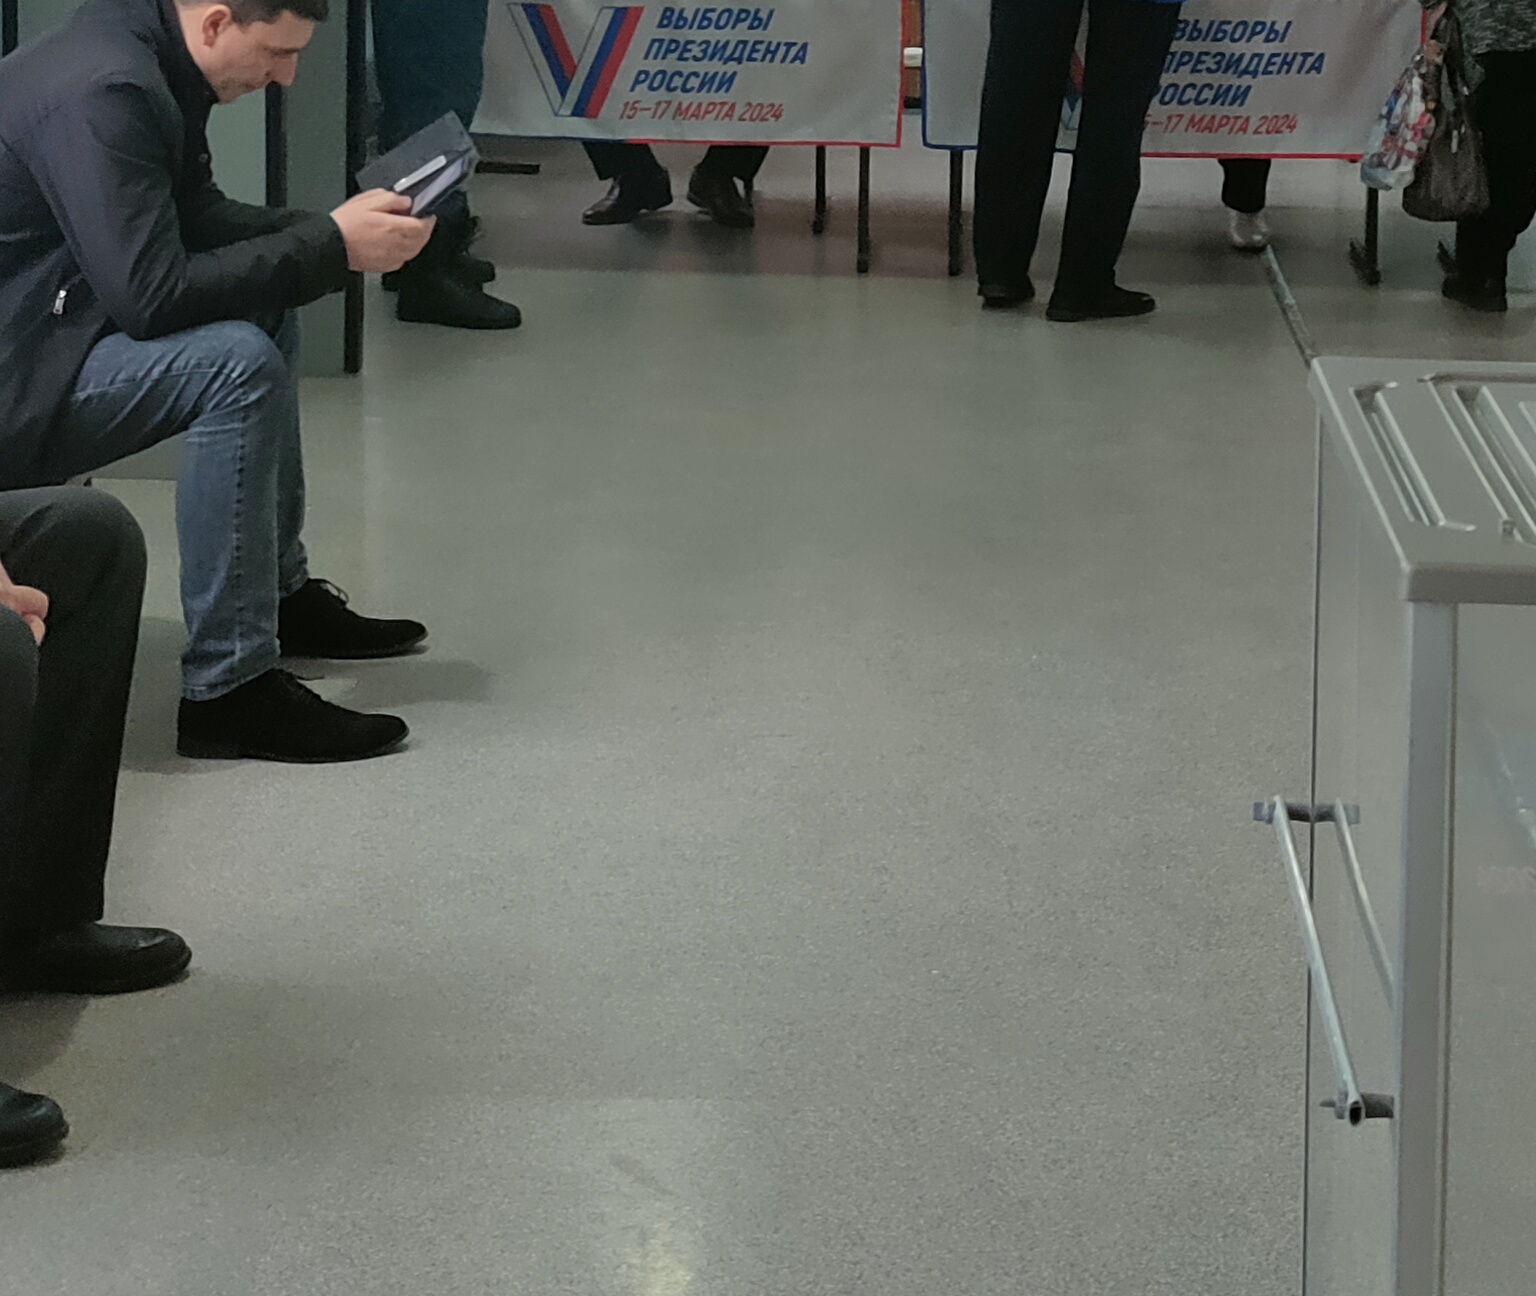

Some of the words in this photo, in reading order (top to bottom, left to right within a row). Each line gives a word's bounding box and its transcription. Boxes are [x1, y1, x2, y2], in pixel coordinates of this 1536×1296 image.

[656, 6, 776, 31] ВЫБОРЫ
[643, 38, 809, 65] ПРЕЗИДЕНТА
[629, 69, 738, 94] РОССИИ
[1157, 82, 1253, 107] ОССИИ
[671, 101, 737, 122] МАРТА
[738, 103, 785, 123] 2024
[1184, 114, 1250, 135] МАРТА
[1252, 114, 1299, 136] 2024
